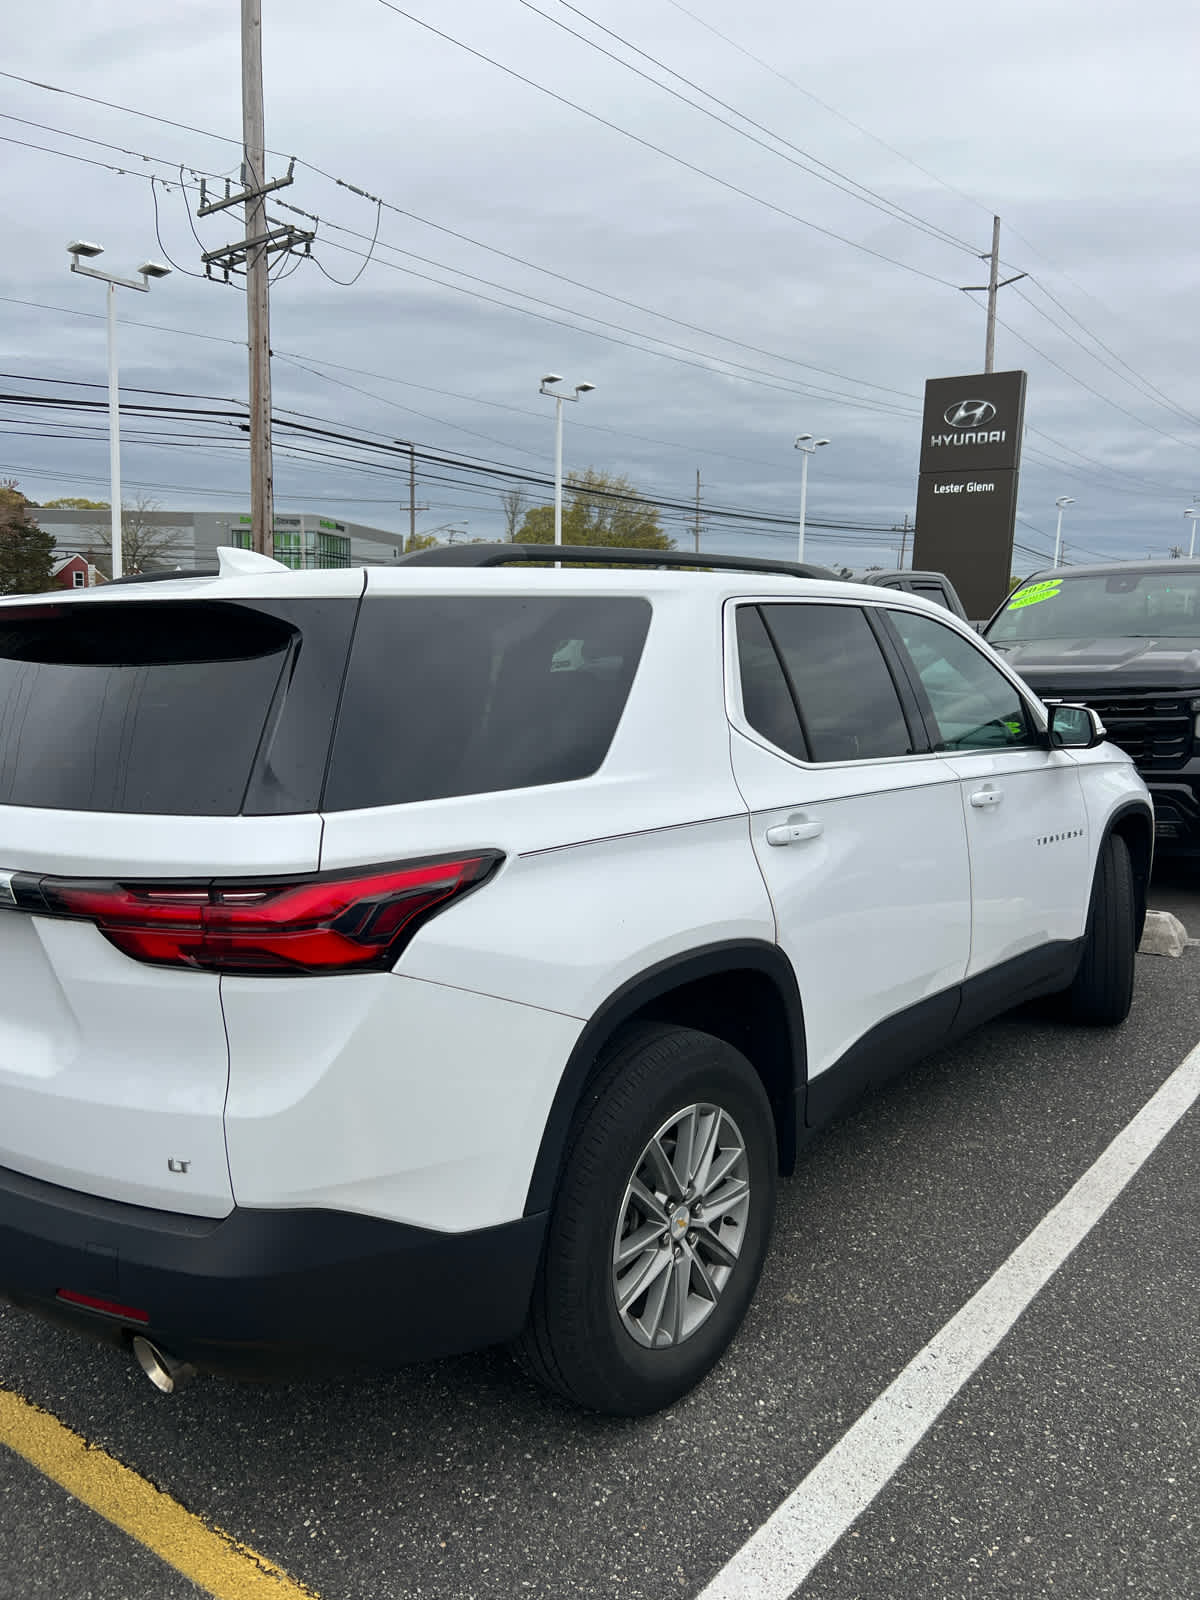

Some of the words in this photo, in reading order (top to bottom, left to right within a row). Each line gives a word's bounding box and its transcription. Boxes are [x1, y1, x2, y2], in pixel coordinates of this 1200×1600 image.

[931, 429, 1007, 447] HYUNDAI
[934, 482, 965, 494] Lester
[966, 481, 995, 493] Glenn
[1036, 828, 1084, 846] TRAVERSE
[167, 1157, 191, 1174] LT
